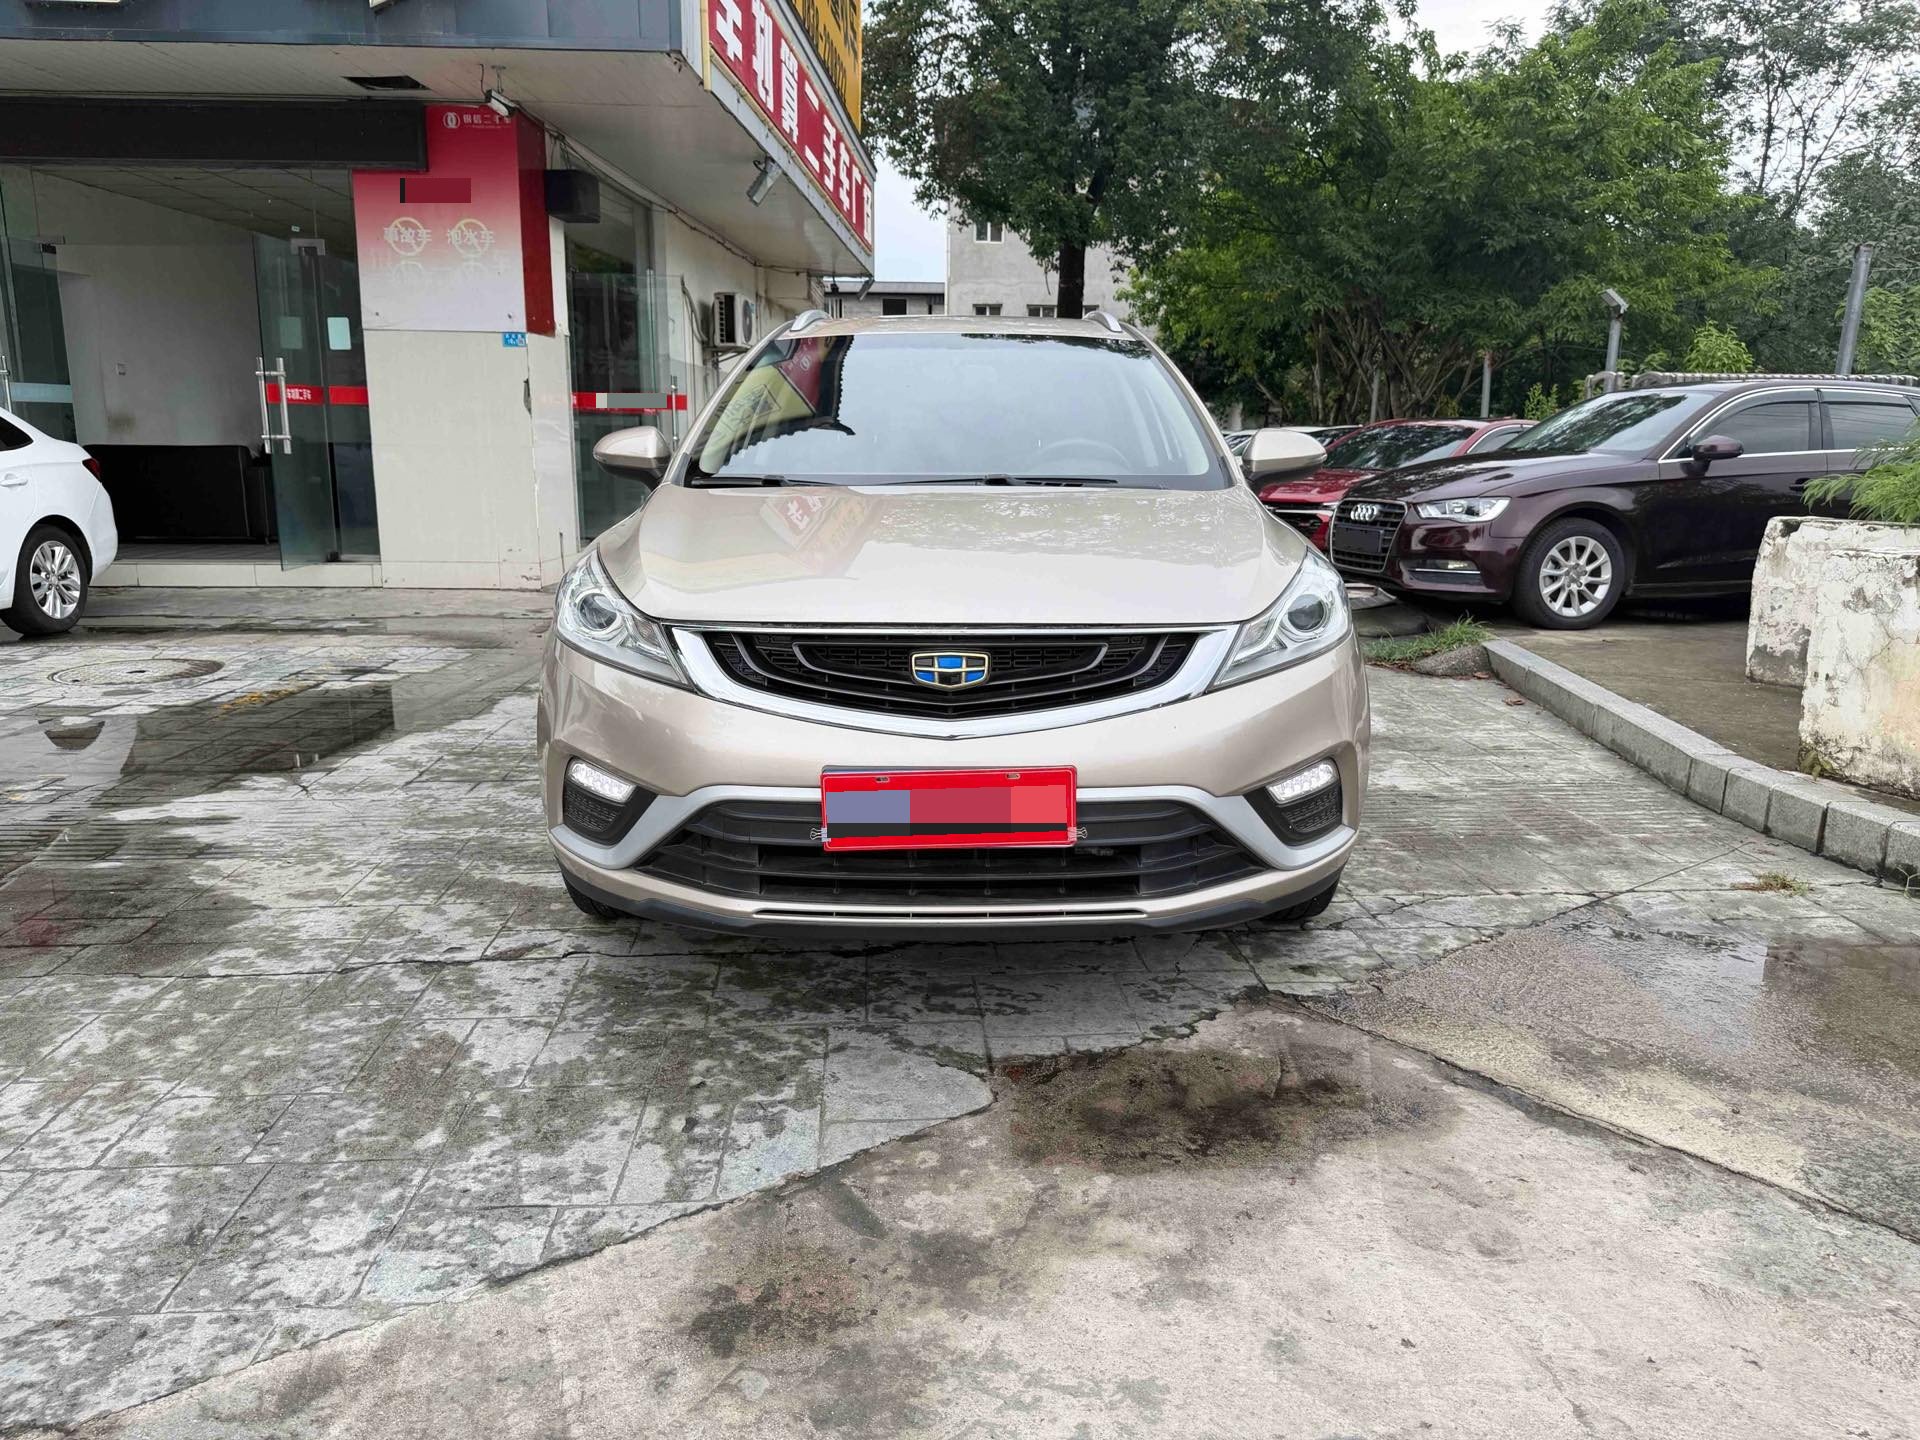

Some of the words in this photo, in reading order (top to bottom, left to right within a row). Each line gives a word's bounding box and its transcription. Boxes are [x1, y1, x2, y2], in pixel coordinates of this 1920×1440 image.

[383, 227, 432, 242] 事故车
[447, 228, 496, 245] 泡水车
